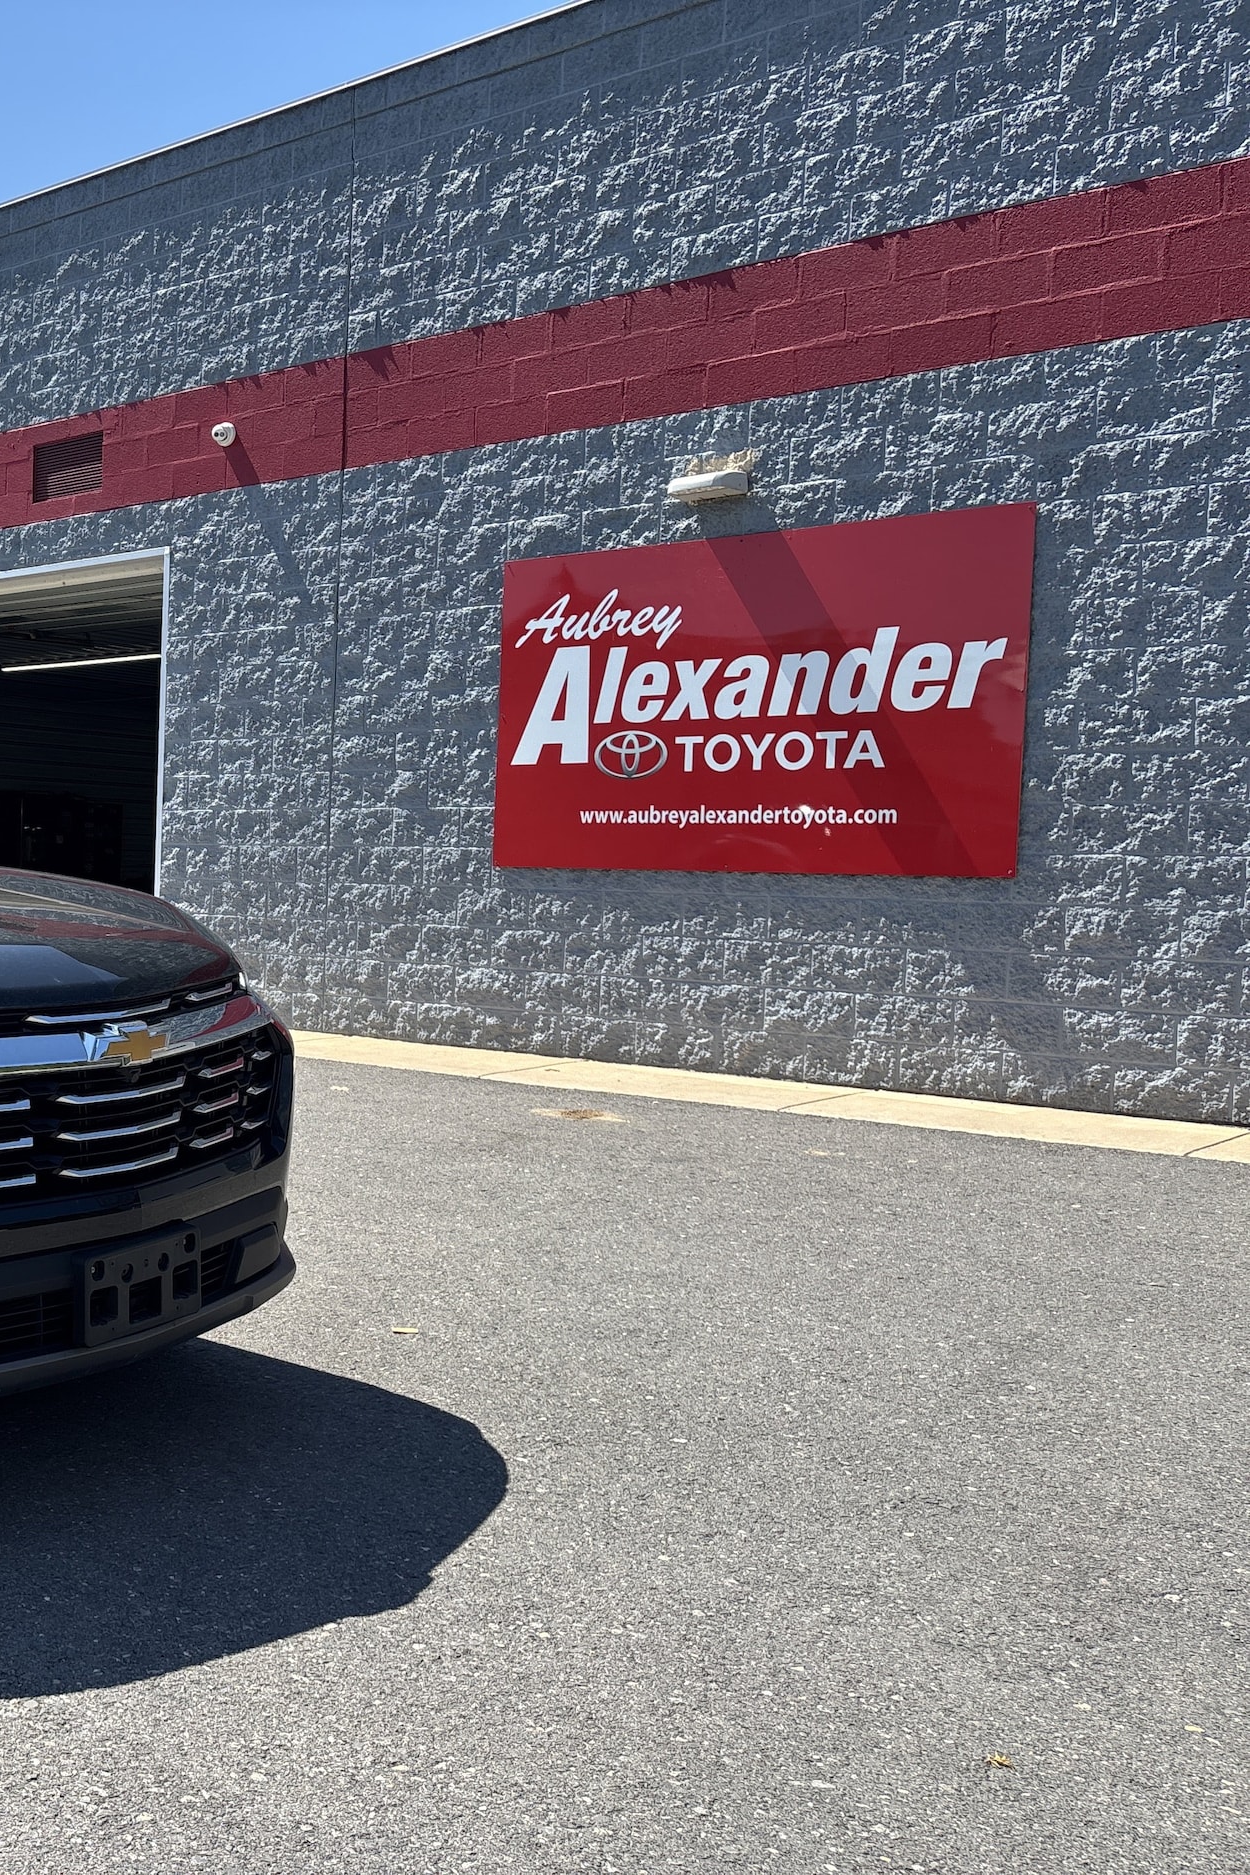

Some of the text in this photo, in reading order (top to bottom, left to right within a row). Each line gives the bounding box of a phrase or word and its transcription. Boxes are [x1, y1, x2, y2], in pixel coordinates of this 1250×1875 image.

[515, 588, 683, 649] Aubrey
[511, 626, 1007, 765] Alexander
[675, 729, 885, 772] TOYOTA
[579, 805, 898, 828] www.aubreyalexandertoyota.com
